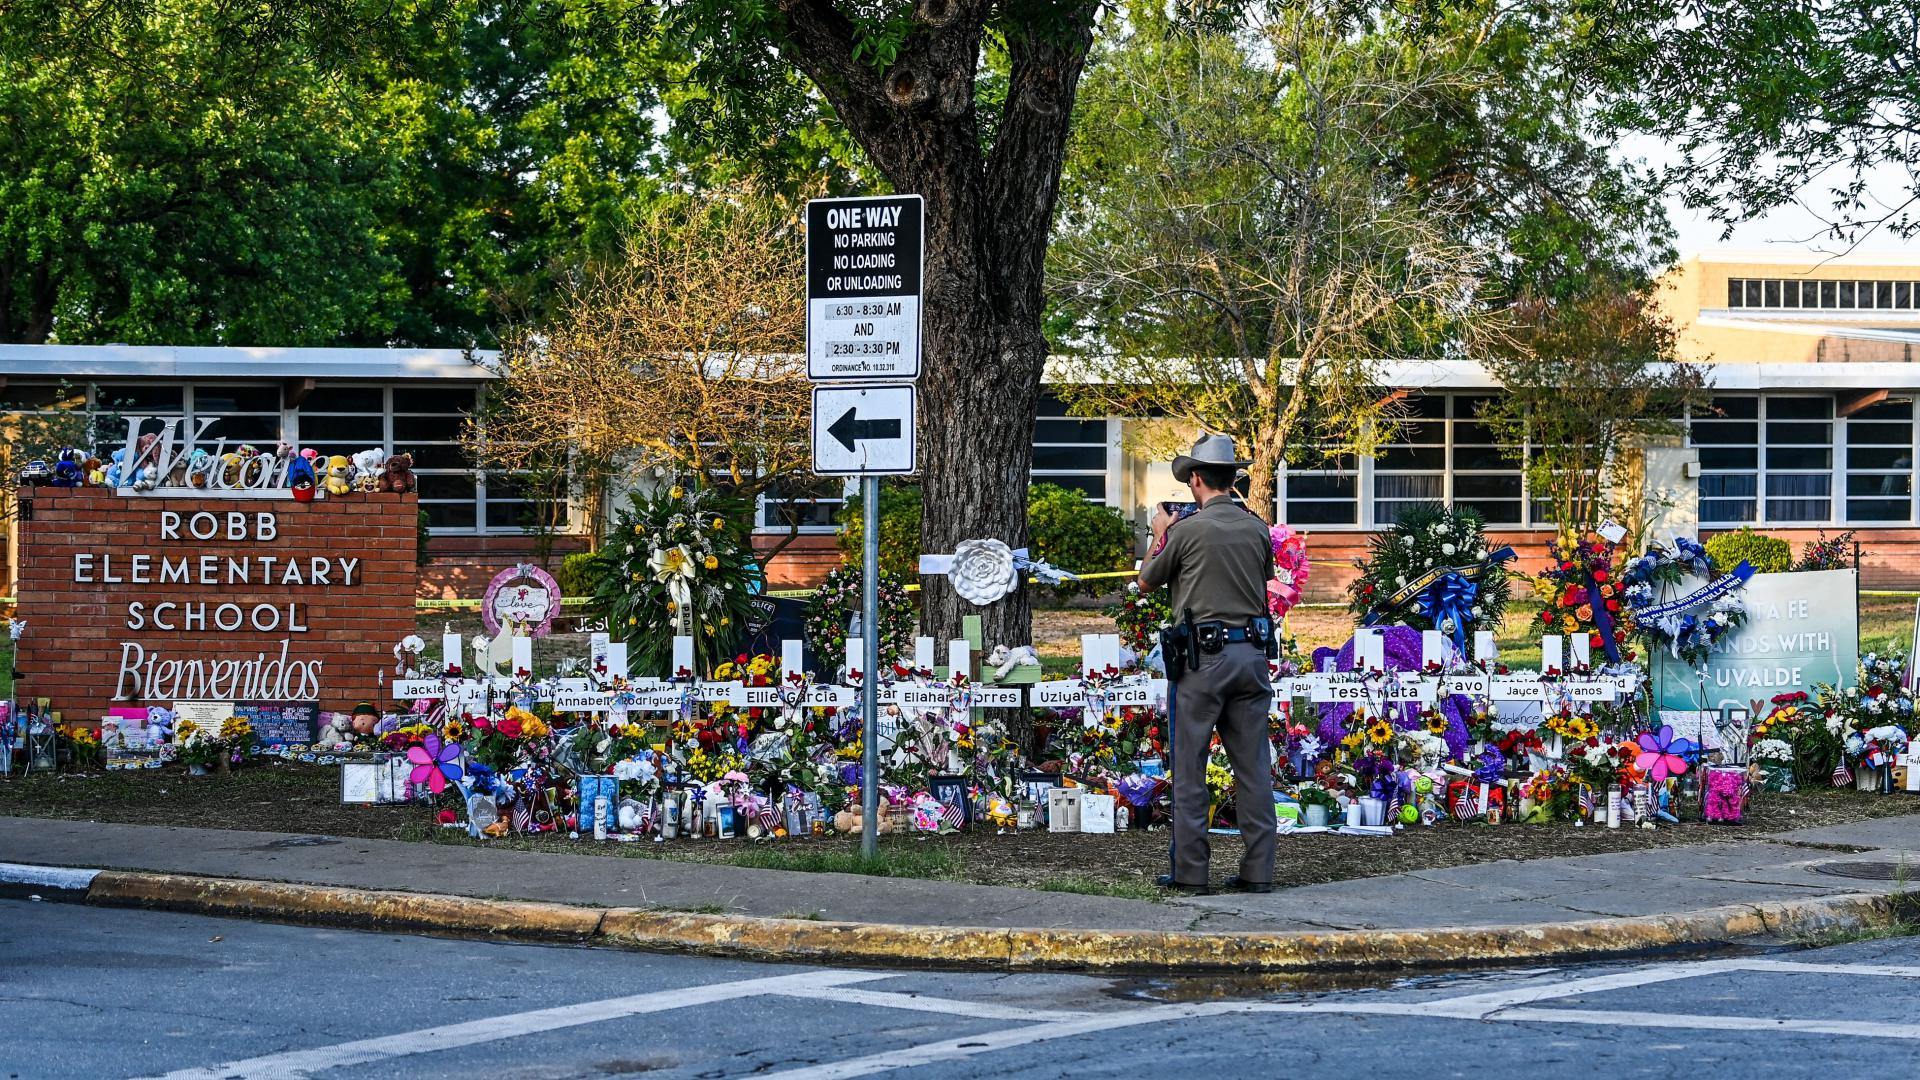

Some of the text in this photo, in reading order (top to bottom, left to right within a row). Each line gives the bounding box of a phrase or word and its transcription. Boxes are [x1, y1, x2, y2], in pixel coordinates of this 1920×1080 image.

[827, 206, 903, 230] ONE WAY
[834, 231, 896, 249] NO PARKING
[834, 253, 896, 270] NO LOADING
[826, 274, 902, 292] OR UNLOADING
[836, 305, 854, 316] 6:30
[862, 304, 884, 316] 8:30
[886, 302, 902, 316] AM
[853, 322, 875, 337] AND
[833, 344, 855, 355] 2:30
[862, 343, 884, 354] 3:30
[885, 341, 900, 355] PM
[831, 364, 862, 372] ORDINANCE
[160, 511, 278, 541] ROBB
[74, 553, 360, 586] ELEMENTARY
[1693, 587, 1709, 598] YOU
[1708, 574, 1735, 590] UVALDE
[1724, 577, 1743, 590] UNIT
[750, 600, 774, 612] OLICE
[1788, 599, 1809, 619] FE
[127, 601, 308, 632] SCHOOL
[1710, 632, 1830, 654] ANDS WITH
[112, 639, 323, 700] Bienvenidos
[1716, 667, 1802, 687] UVALDE
[403, 684, 444, 696] Jackie
[747, 691, 779, 703] Ellie
[975, 692, 1017, 703] orres
[1107, 690, 1147, 701] arcia
[1328, 687, 1369, 699] Tess
[1506, 686, 1539, 697] Jayce
